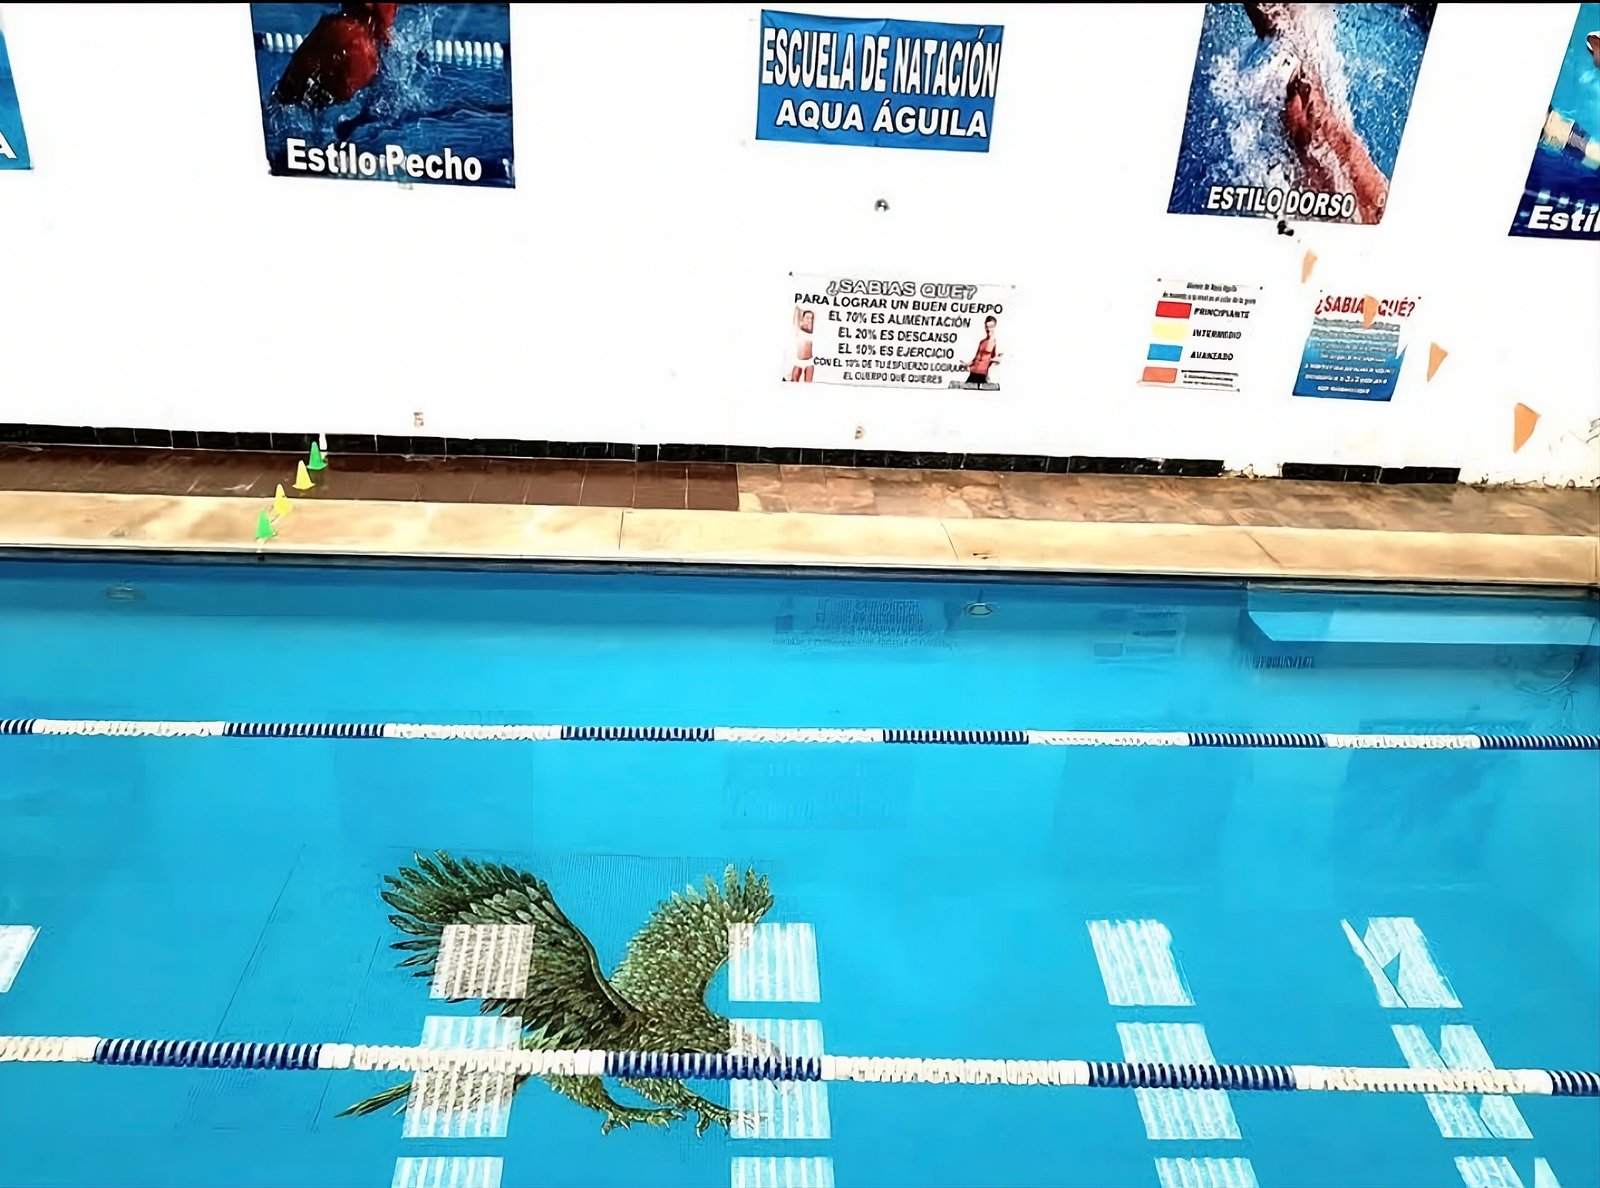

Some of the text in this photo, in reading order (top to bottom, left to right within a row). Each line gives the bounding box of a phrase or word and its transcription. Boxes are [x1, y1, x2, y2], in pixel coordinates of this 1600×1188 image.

[762, 27, 1000, 98] ESCUELA DE NATACIÓN
[775, 99, 988, 138] AQUA ÁGUILA
[385, 144, 482, 181] Pecho
[1207, 186, 1356, 218] ESTILO DORSO
[826, 279, 978, 300] ¿SABIAS QUE?
[794, 293, 1003, 315] PARA LOGRAR UN BUEN CUERPO
[1314, 295, 1372, 316] ¿SABIA
[828, 310, 971, 328] EL 70% ES ALIMENTACIÓN
[838, 327, 958, 343] EL 20% ES DESCANSO
[838, 343, 955, 359] EL 10% ES EJERCICIO
[813, 357, 833, 368] CON
[833, 358, 843, 368] EL
